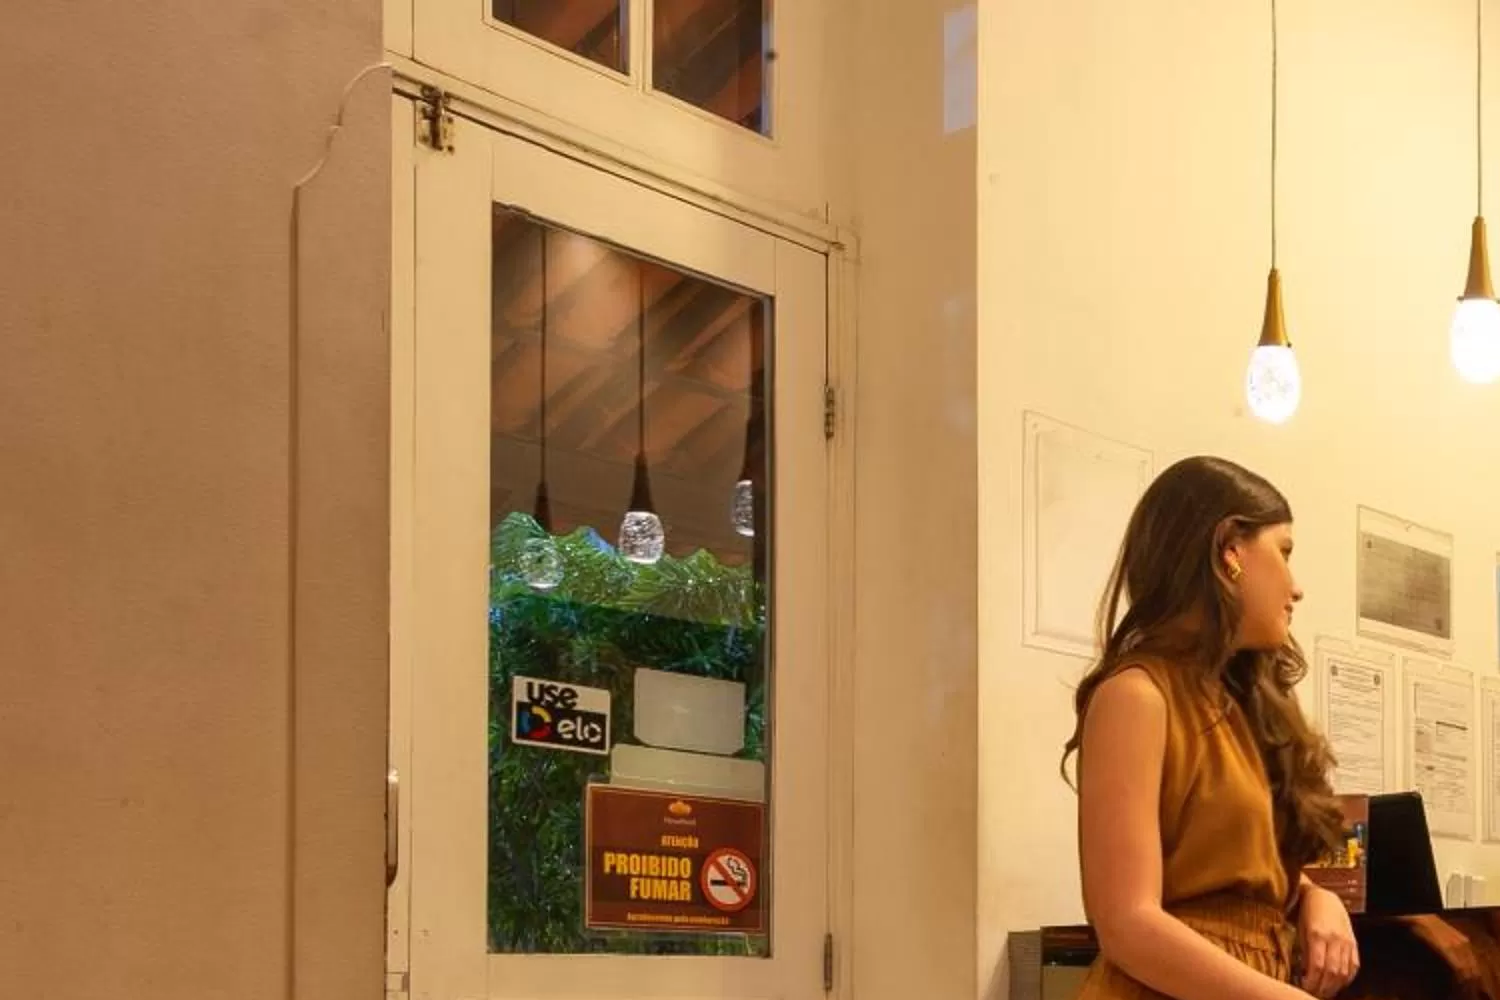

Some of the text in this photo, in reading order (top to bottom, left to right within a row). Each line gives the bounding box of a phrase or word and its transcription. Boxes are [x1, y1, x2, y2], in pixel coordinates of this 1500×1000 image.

[526, 681, 579, 709] use
[557, 715, 602, 743] elo
[603, 851, 692, 879] PROIBIDO
[630, 877, 692, 901] FUMAR
